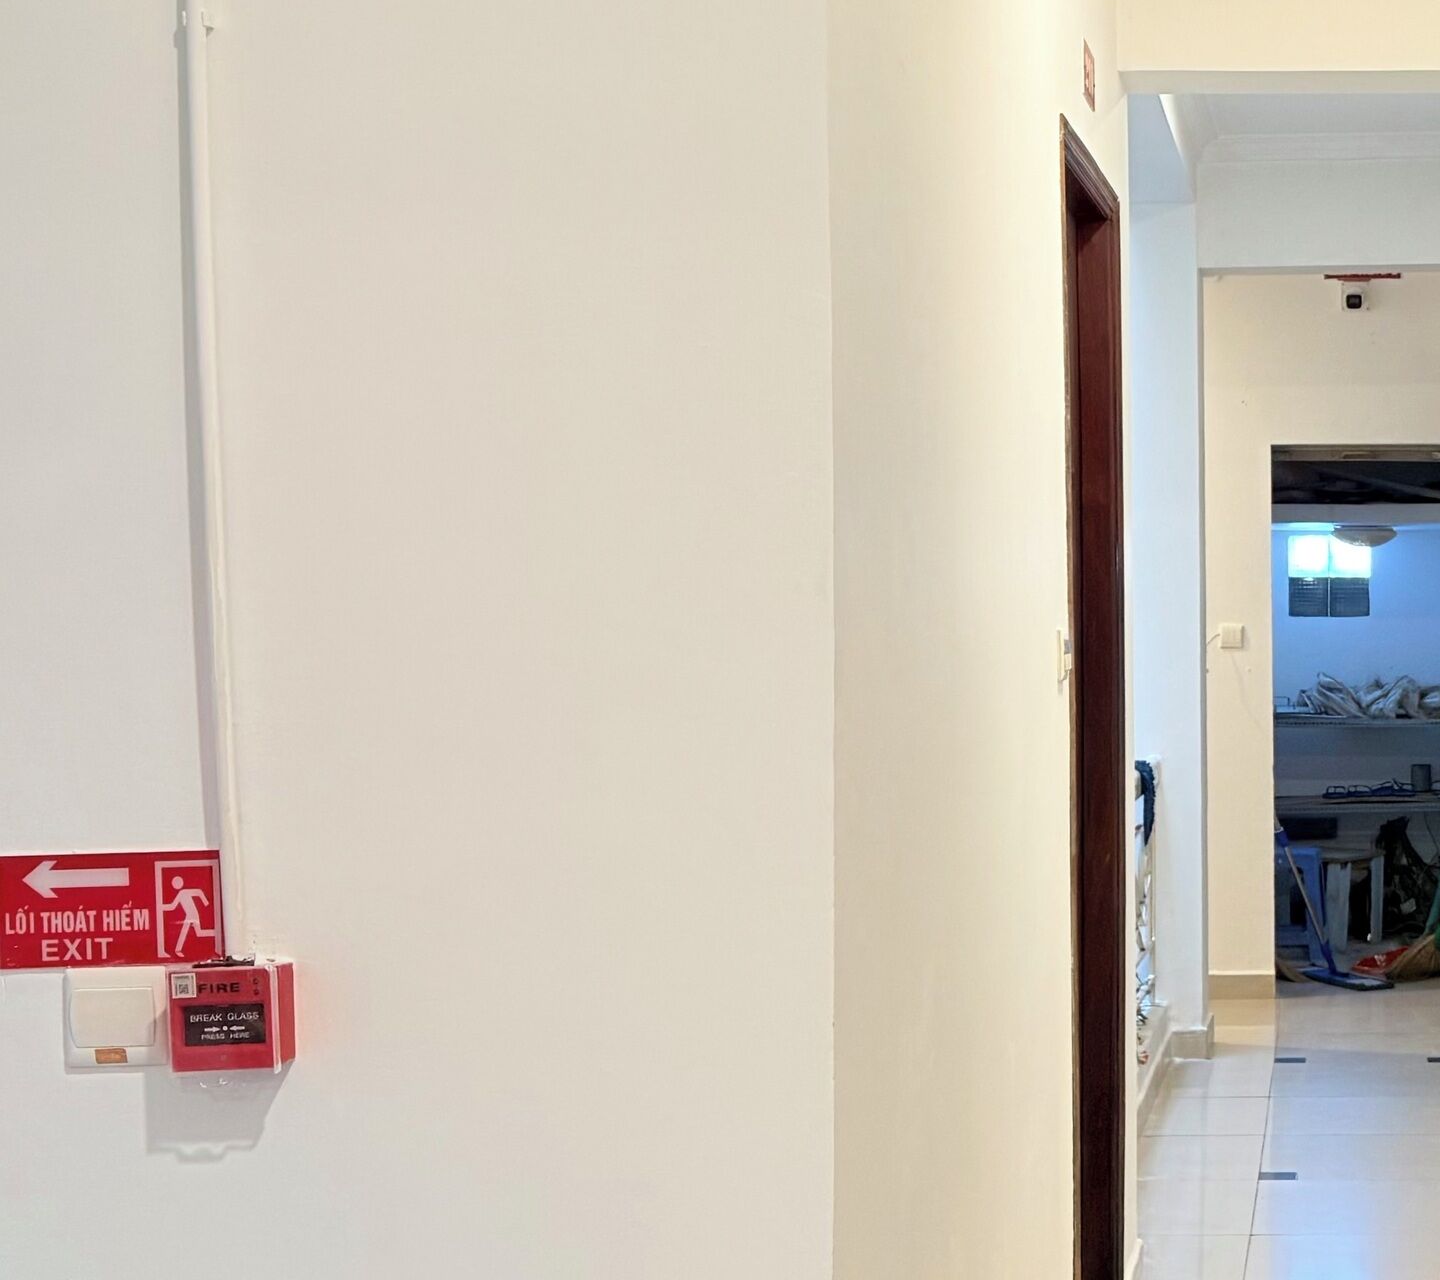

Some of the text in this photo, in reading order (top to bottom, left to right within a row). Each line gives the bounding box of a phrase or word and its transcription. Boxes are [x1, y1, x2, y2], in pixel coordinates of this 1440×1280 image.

[5, 904, 35, 935] LỐI
[40, 905, 97, 933] THOÁT
[41, 937, 113, 962] EXIT
[198, 982, 240, 993] FIRE
[189, 1011, 260, 1023] BREAK GLASS
[201, 1031, 250, 1041] PRESS HERE
